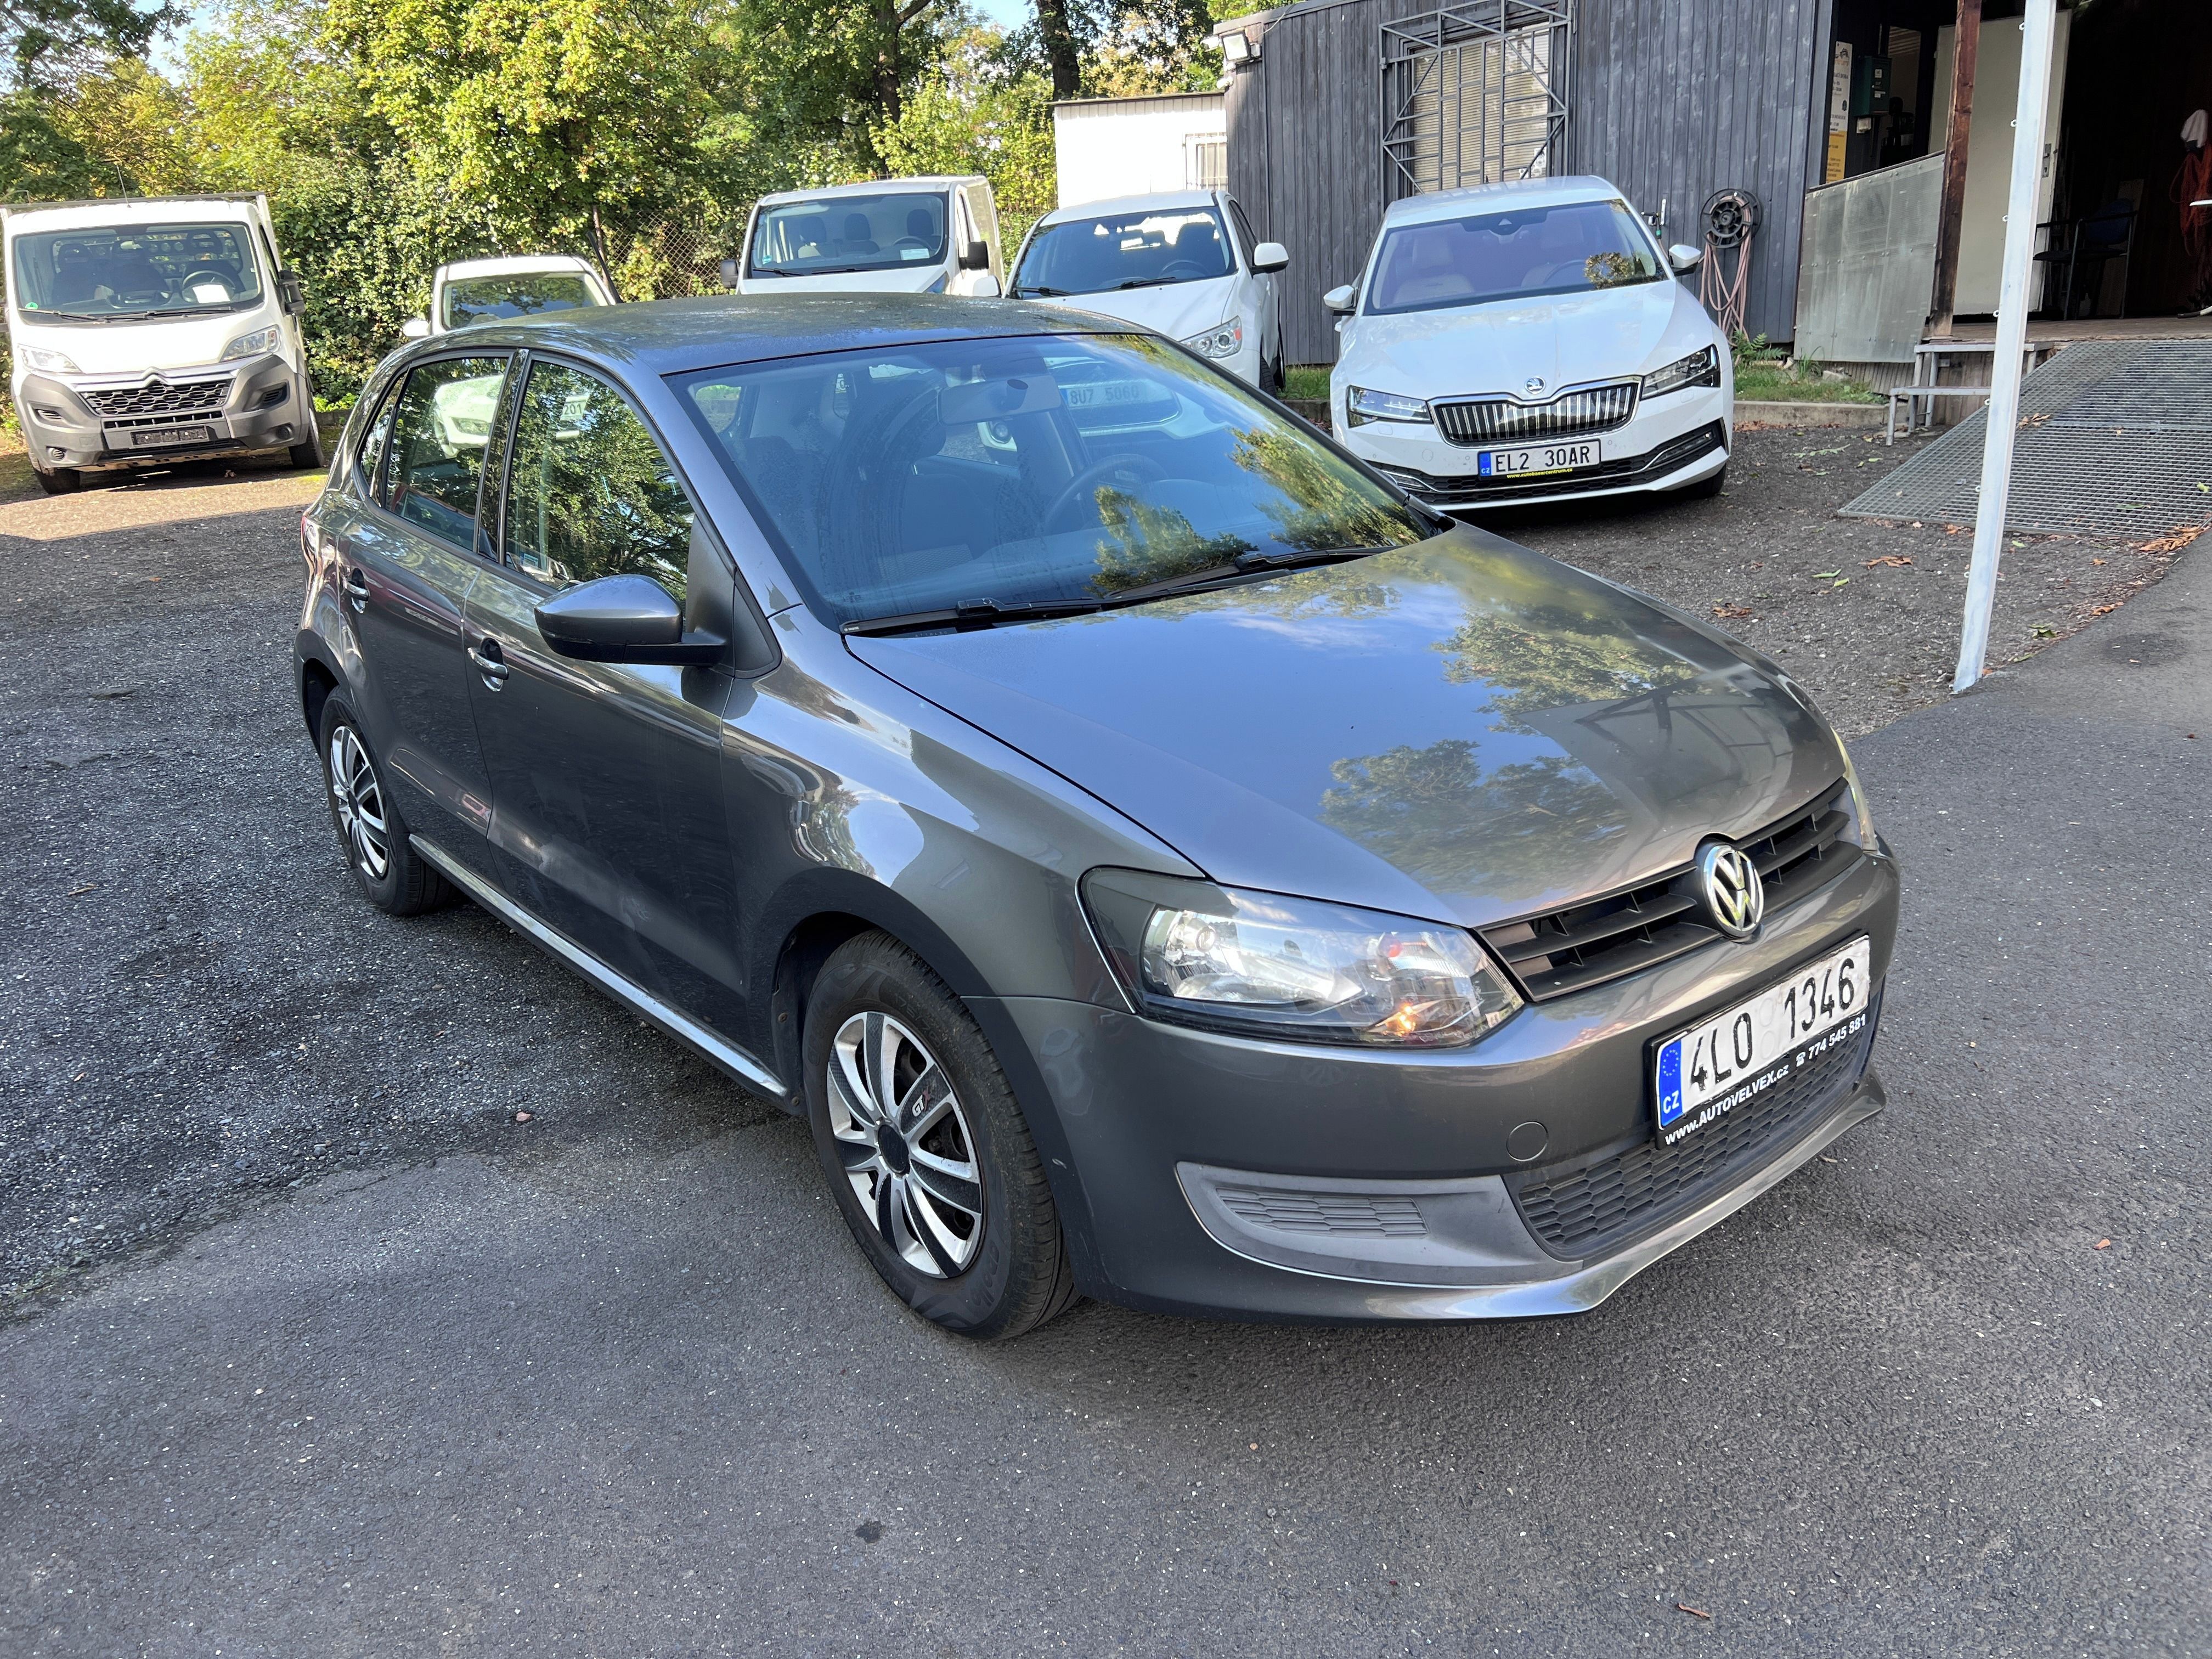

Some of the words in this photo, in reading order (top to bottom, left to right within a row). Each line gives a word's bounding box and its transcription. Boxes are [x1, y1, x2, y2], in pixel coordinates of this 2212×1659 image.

[1070, 389, 1093, 404] 8U7
[1496, 453, 1530, 473] EL2
[1544, 445, 1590, 467] 30AR
[1784, 958, 1855, 1040] 1346
[1664, 1064, 1790, 1145] www.AUTOVELVEX.cz
[1808, 1038, 1827, 1059] 774
[1829, 1025, 1847, 1047] 545
[1663, 1090, 1680, 1114] CZ
